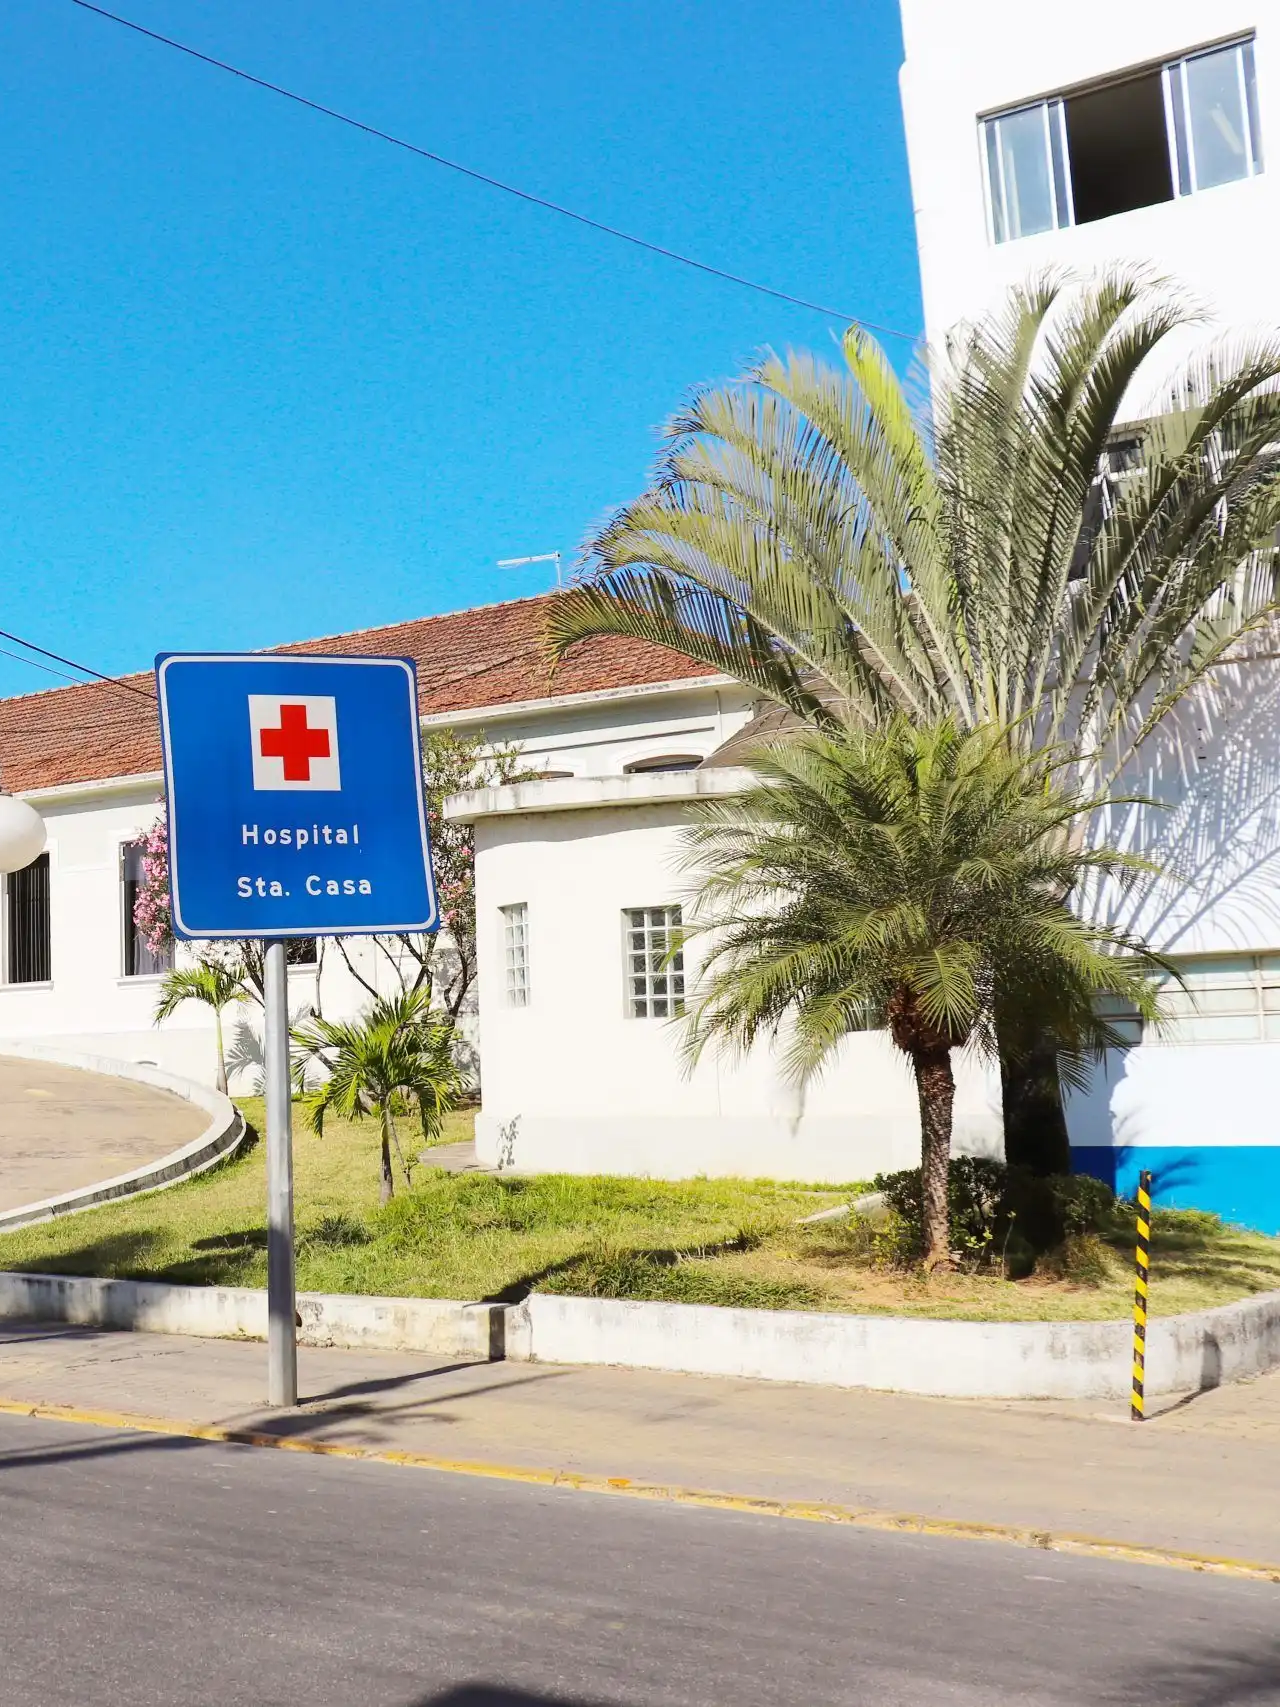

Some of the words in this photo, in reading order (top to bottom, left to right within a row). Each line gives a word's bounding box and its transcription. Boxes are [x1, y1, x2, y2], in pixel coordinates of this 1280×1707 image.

[242, 824, 359, 850] Hospital
[237, 876, 290, 898] Sta.
[305, 875, 372, 896] Casa
